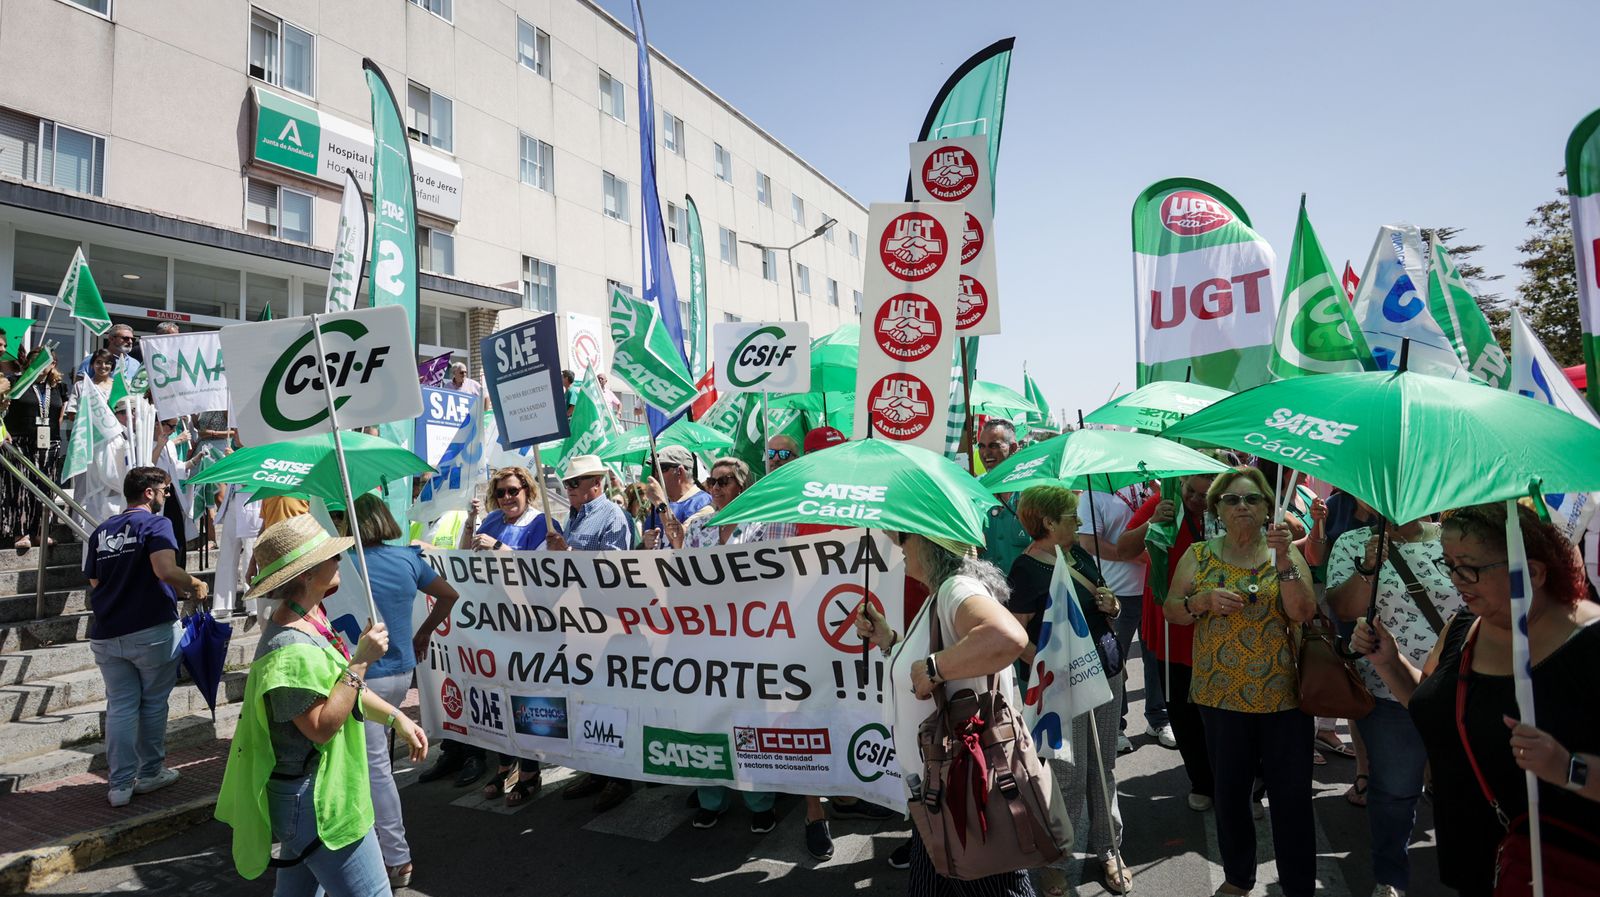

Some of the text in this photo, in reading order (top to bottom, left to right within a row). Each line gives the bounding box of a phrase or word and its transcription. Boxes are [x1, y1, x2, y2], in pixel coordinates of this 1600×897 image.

[262, 137, 279, 148] Junta
[328, 142, 368, 164] Hospital
[327, 160, 367, 181] Hosital
[932, 150, 966, 170] UGT
[425, 176, 457, 194] de Jerez
[416, 188, 440, 204] nfantil
[1169, 196, 1223, 217] UGT
[894, 219, 935, 240] UGT
[1150, 268, 1270, 330] UGT
[156, 311, 183, 321] SALIDA
[888, 299, 929, 321] UGT
[612, 350, 689, 406] SATSE
[882, 378, 921, 399] UGT
[1264, 407, 1360, 445] SATSE
[1243, 432, 1327, 467] Cádiz
[260, 458, 315, 475] SATSE
[252, 470, 304, 486] Cádiz
[802, 481, 889, 502] SATSE
[797, 500, 882, 521] Cádiz
[449, 556, 587, 589] DEFENSA
[592, 557, 648, 589] DE
[654, 535, 889, 588] NUESTRA
[456, 598, 797, 639] SANIDAD PÚBLICA
[458, 645, 497, 679] NO
[508, 644, 594, 686] MÁS
[606, 654, 812, 701] RECORTES
[762, 733, 826, 749] CCOO
[647, 740, 727, 770] SATSE
[737, 752, 773, 760] federación
[784, 754, 813, 762] sanidad
[856, 740, 896, 768] CSIF
[774, 764, 830, 772] sociosanitarios
